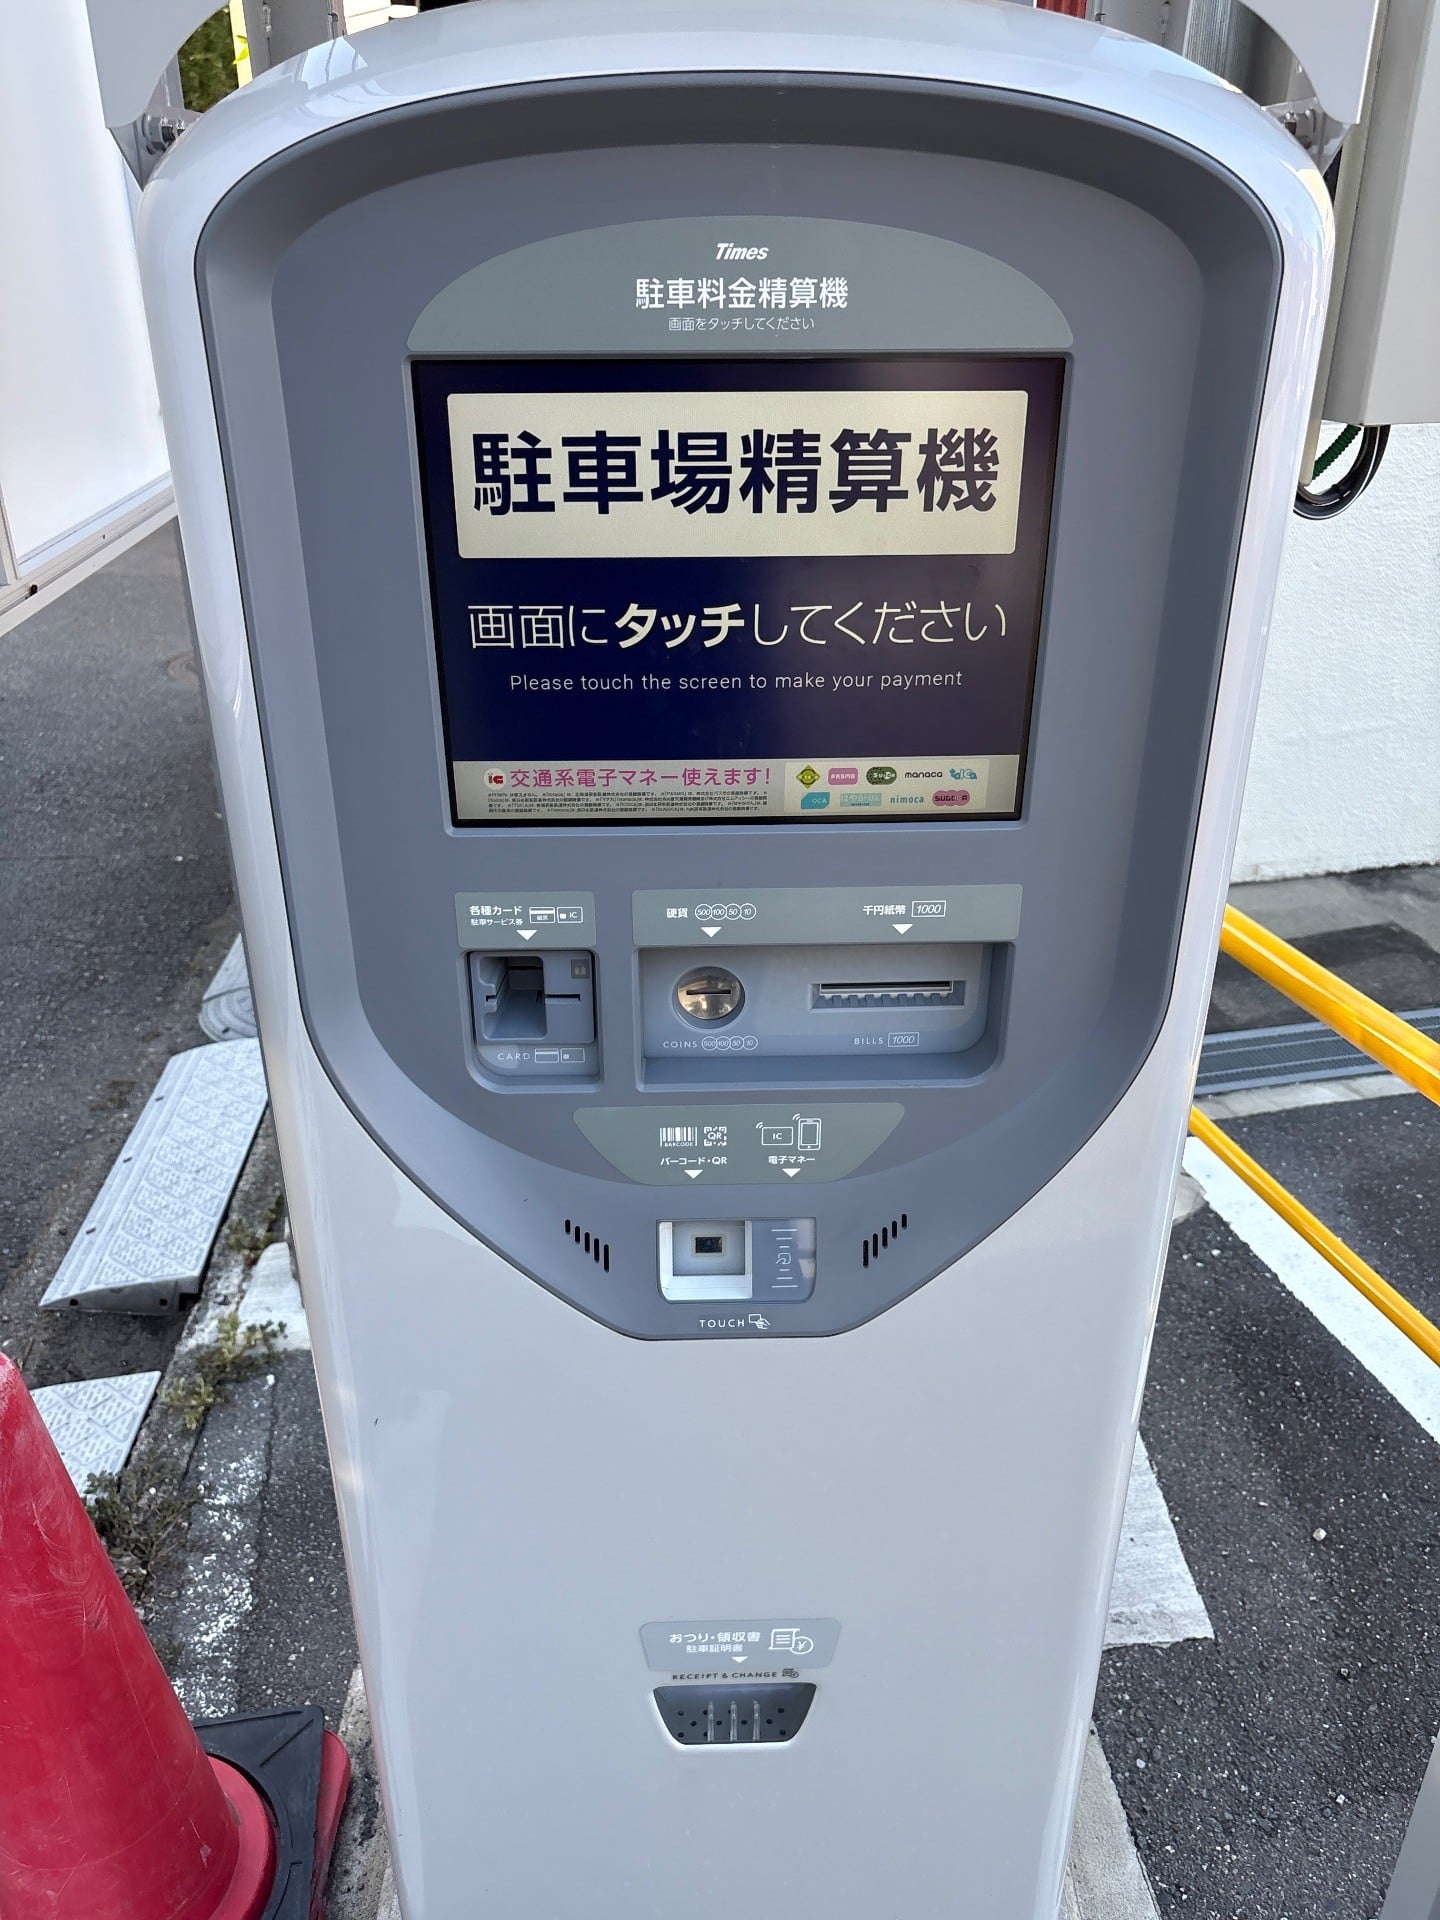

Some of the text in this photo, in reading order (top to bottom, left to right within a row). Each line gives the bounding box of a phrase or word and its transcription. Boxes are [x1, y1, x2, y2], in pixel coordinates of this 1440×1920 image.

[715, 243, 769, 261] Times
[635, 277, 849, 311] 駐車料金精算機
[668, 316, 815, 332] 画面をタッチしてください
[472, 427, 1000, 515] 駐車場精算機
[467, 600, 1007, 649] 画面にタッチしてください
[510, 671, 963, 691] Please touch the screen to make your payment
[470, 906, 522, 915] 各種カード
[666, 908, 688, 919] 硬貨
[697, 908, 752, 916] 500 100 50 10
[863, 904, 906, 916] 千円紙幣
[916, 904, 942, 914] 1000
[470, 918, 523, 926] 駐車サービス券
[663, 1040, 697, 1049] COINS
[854, 1036, 915, 1045] BILLS 1000
[497, 1052, 530, 1060] CARD
[708, 1132, 722, 1140] QR
[768, 1155, 815, 1164] 電子マネー
[699, 1319, 745, 1328] TOUCH
[669, 1631, 761, 1643] おつり・領収書
[686, 1644, 743, 1653] 駐車証明書
[672, 1672, 718, 1680] RECEIPT
